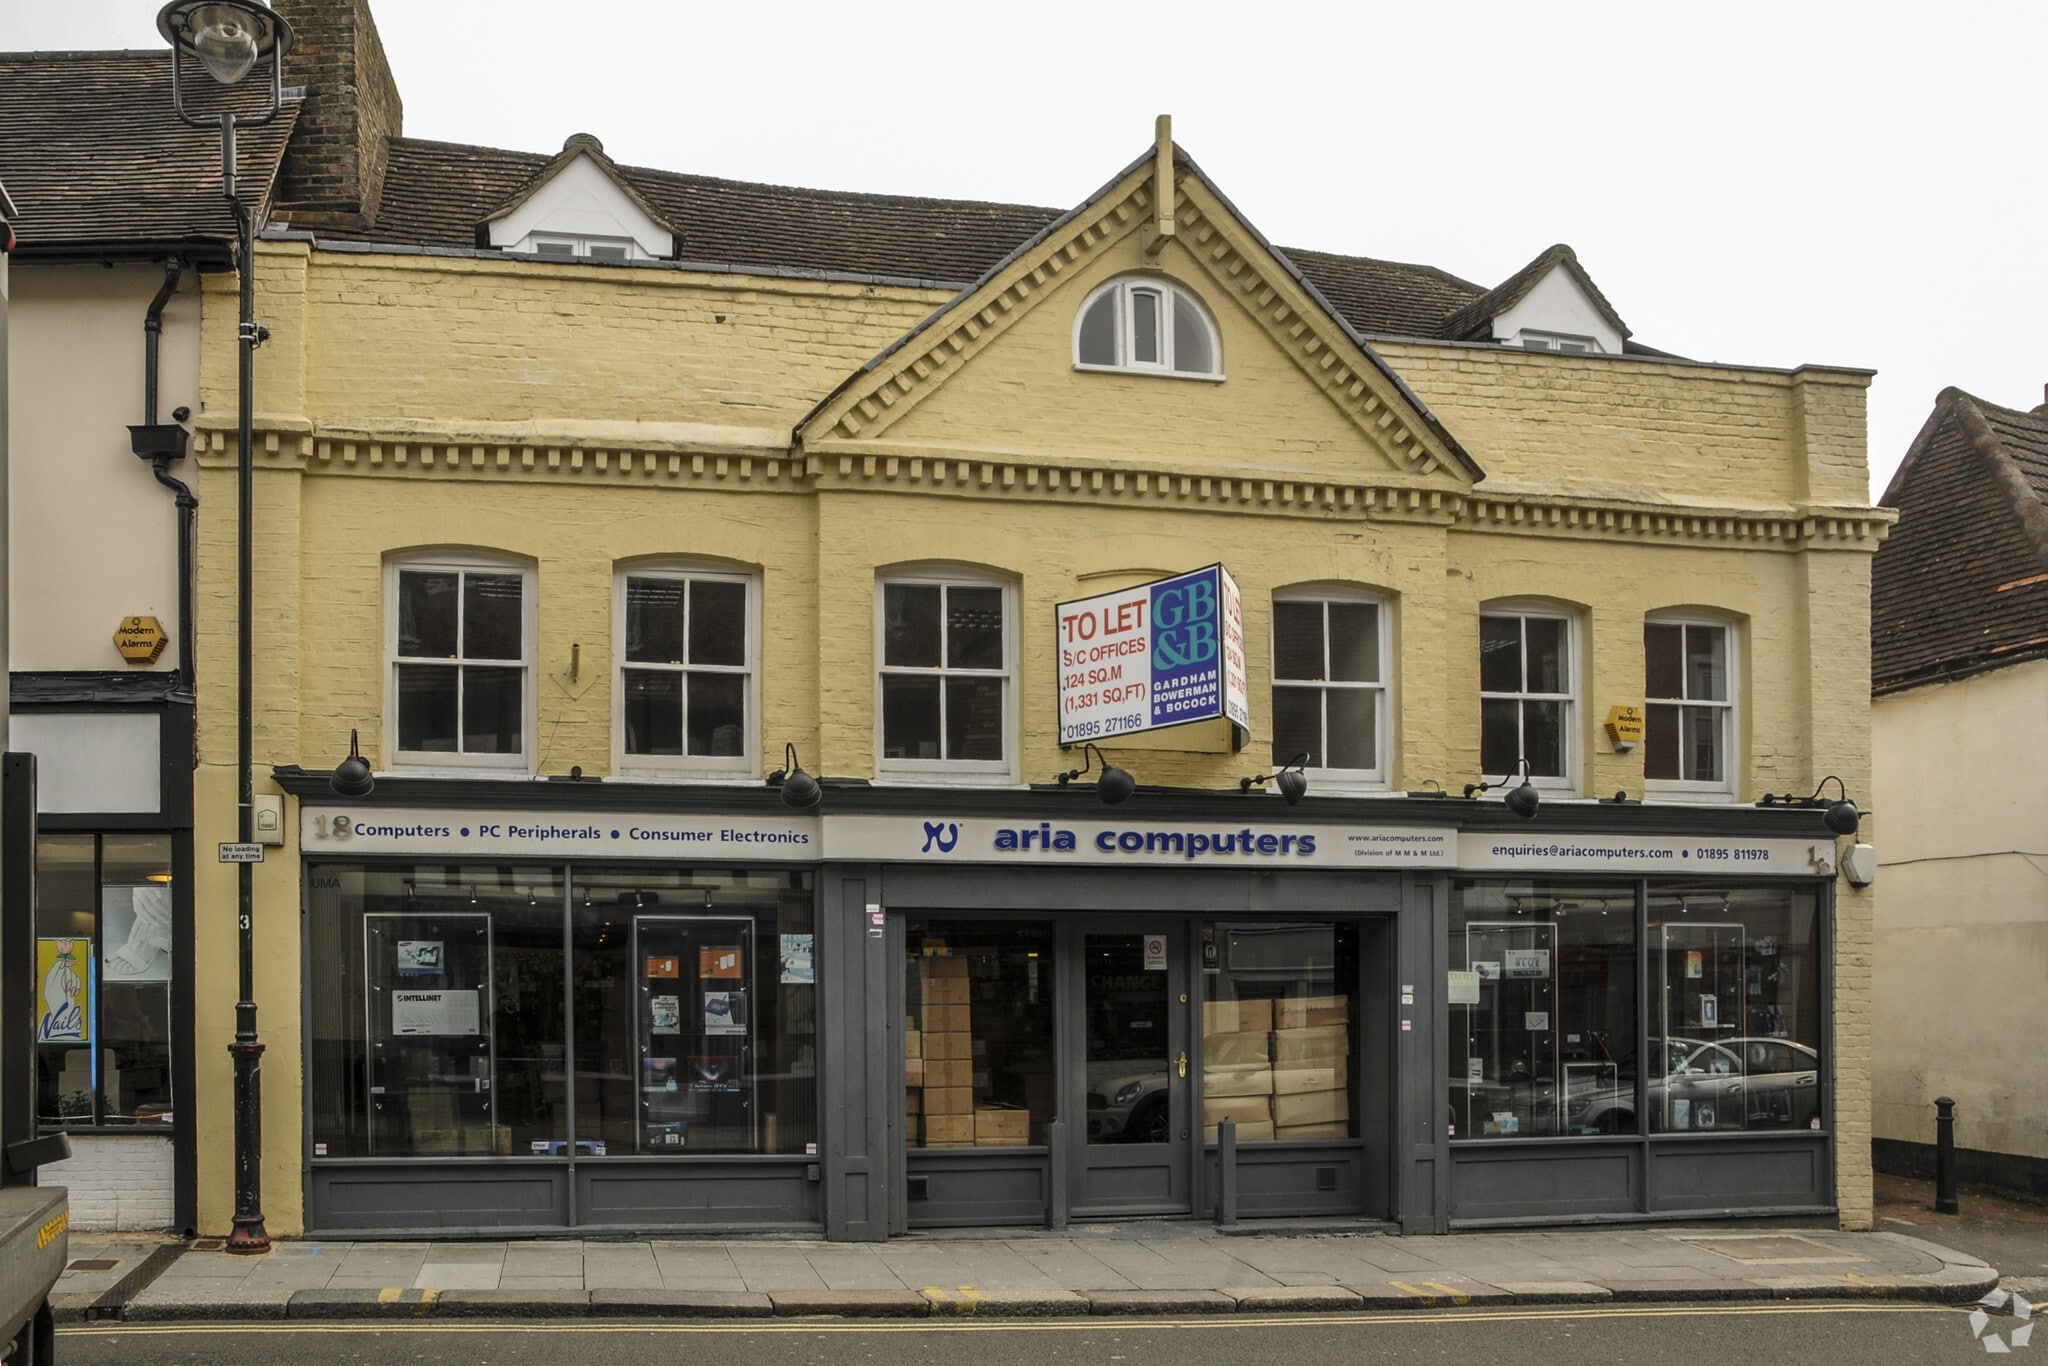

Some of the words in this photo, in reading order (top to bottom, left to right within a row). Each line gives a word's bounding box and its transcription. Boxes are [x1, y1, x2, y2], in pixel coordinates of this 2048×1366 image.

[1153, 579, 1216, 629] GB
[119, 626, 155, 635] Modern
[1063, 612, 1097, 643] TO
[1104, 599, 1148, 636] LET
[121, 639, 153, 648] Alarms
[1063, 650, 1087, 668] S/C
[1089, 637, 1146, 662] OFFICES
[1152, 621, 1217, 671] &B
[1065, 672, 1085, 690] 124
[1088, 665, 1122, 685] SQ.M
[1154, 670, 1217, 691] GARDHAM
[1065, 692, 1098, 714] (1,331
[1103, 682, 1146, 705] SQ,FT)
[1154, 682, 1217, 703] BOWERMAN
[1154, 704, 1161, 715] &
[1166, 695, 1216, 713] BOCOCK
[1066, 720, 1101, 739] 01895
[1104, 713, 1142, 733] 271166
[1618, 714, 1642, 723] Modern
[313, 814, 351, 841] 18
[354, 823, 450, 839] Computers
[479, 825, 501, 838] PC
[508, 825, 601, 841] Peripherals
[629, 827, 714, 842] Consumer
[720, 829, 809, 844] Electronics
[994, 822, 1077, 851] aria
[1095, 828, 1318, 860] computers
[1348, 834, 1444, 843] www.ariacomputers.com
[1492, 844, 1673, 859] enquiries@ariacomputers.com
[1697, 848, 1729, 860] 01895
[1734, 849, 1769, 860] 811978
[240, 915, 250, 929] 3
[38, 1001, 83, 1039] Nails
